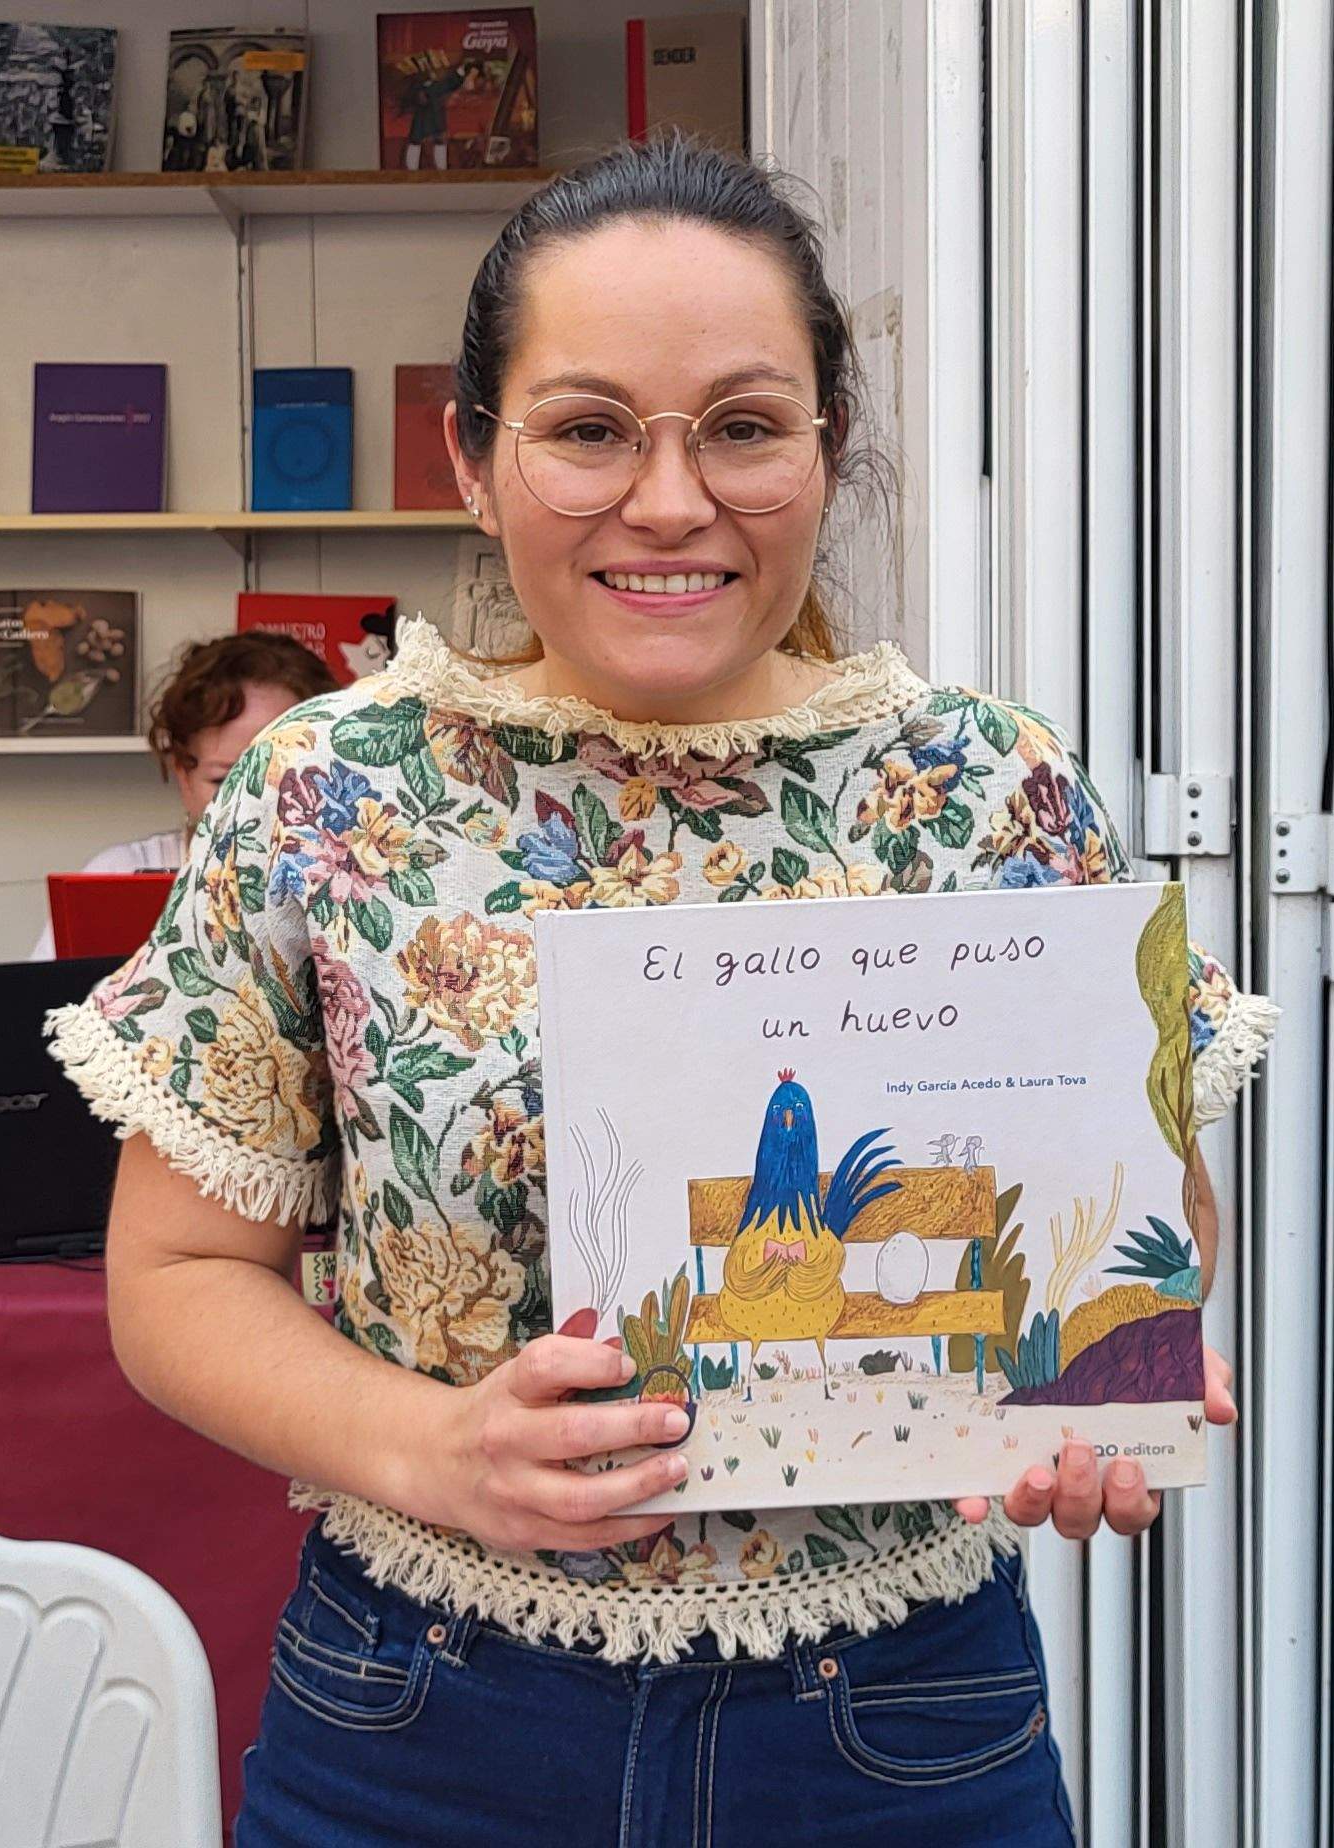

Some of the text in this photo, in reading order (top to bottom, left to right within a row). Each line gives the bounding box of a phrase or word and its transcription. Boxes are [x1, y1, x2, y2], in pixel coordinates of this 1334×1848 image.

[643, 935, 1046, 986] El gallo que puso
[762, 1000, 959, 1039] un huevo
[886, 1074, 1088, 1096] Indy García Acedo & Laura Tova
[1123, 1442, 1175, 1456] editora
